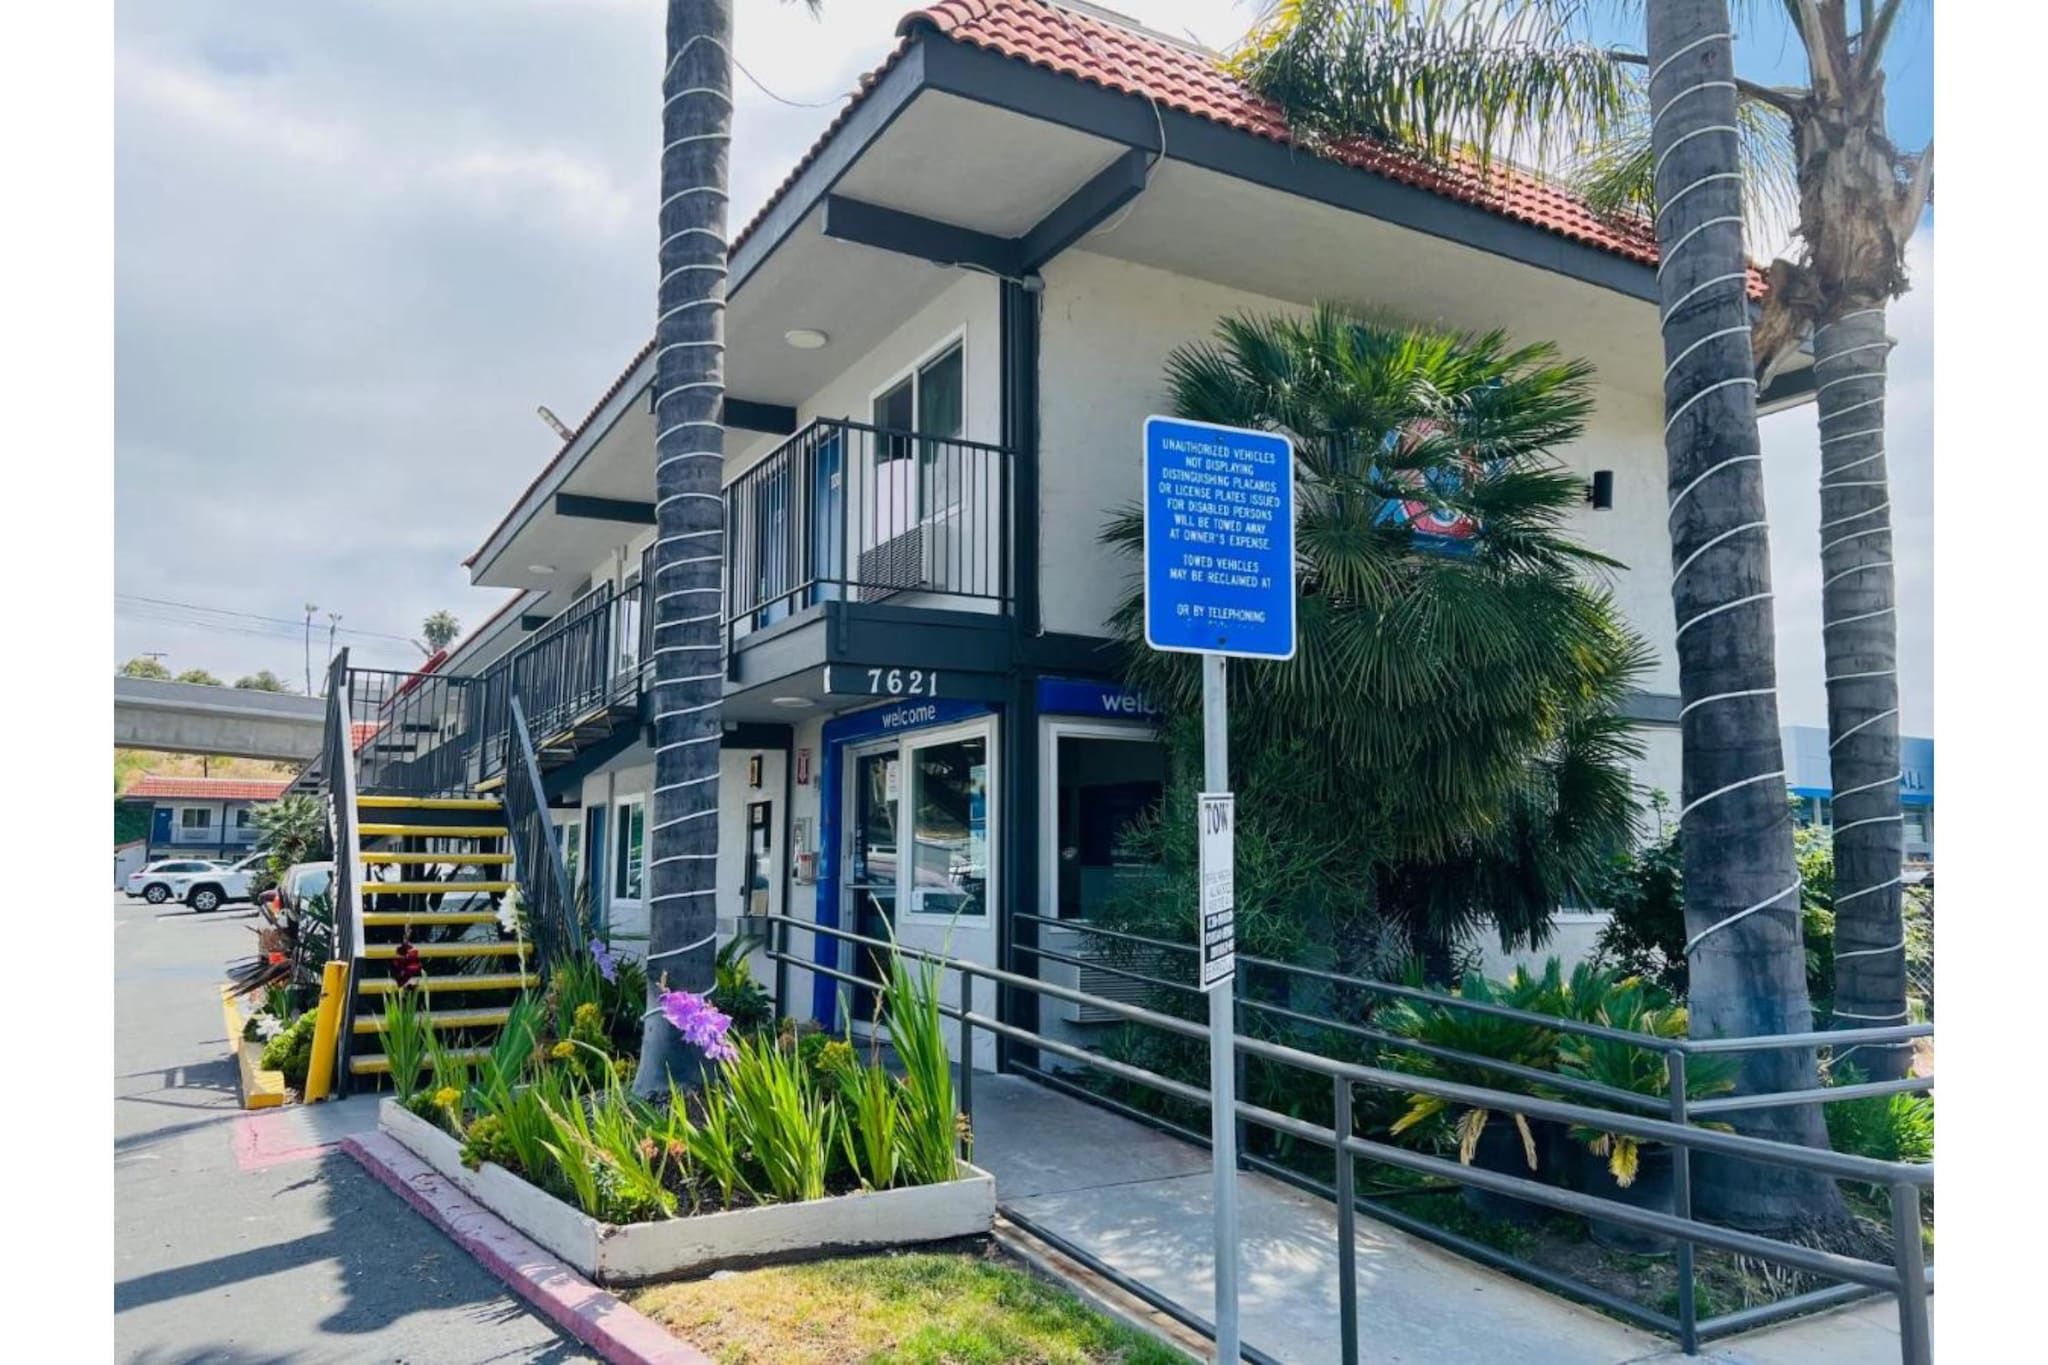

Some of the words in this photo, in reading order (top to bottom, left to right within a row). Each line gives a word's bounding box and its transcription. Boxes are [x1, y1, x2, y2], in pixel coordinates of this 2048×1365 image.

[1162, 438, 1230, 458] UNAUTHORIZED
[1234, 448, 1276, 464] VEHICLES
[1186, 456, 1201, 468] NOT
[1206, 459, 1254, 476] DISPLAYING
[1162, 467, 1230, 488] DISTINGUISHING
[1232, 477, 1277, 493] PLACARDS
[1158, 481, 1172, 494] OR
[1175, 484, 1211, 500] LICENSE
[1215, 489, 1246, 503] PLATES
[1250, 493, 1281, 508] ISSUED
[1167, 498, 1185, 510] FOR
[1188, 500, 1230, 516] DISABLED
[1232, 506, 1273, 521] PERSONS
[1174, 514, 1194, 527] WILL
[1198, 516, 1209, 528] BE
[1213, 518, 1242, 532] TOWED
[1245, 522, 1267, 534] AWAY
[1169, 528, 1180, 539] AT
[1184, 529, 1225, 546] OWNER'S
[1229, 535, 1271, 550] EXPENSE.
[1183, 554, 1213, 568] TOWED
[1216, 558, 1259, 573] VEHICLES
[1169, 568, 1187, 580] MAY
[1191, 570, 1203, 582] BE
[1208, 572, 1258, 588] RECLAIMED
[1261, 577, 1271, 589] AT
[1177, 604, 1190, 617] OR
[1193, 604, 1204, 617] BY
[1208, 606, 1266, 624] TELEPHONING
[868, 668, 937, 697] 7621
[882, 704, 936, 729] welcome
[1205, 802, 1229, 835] TOW
